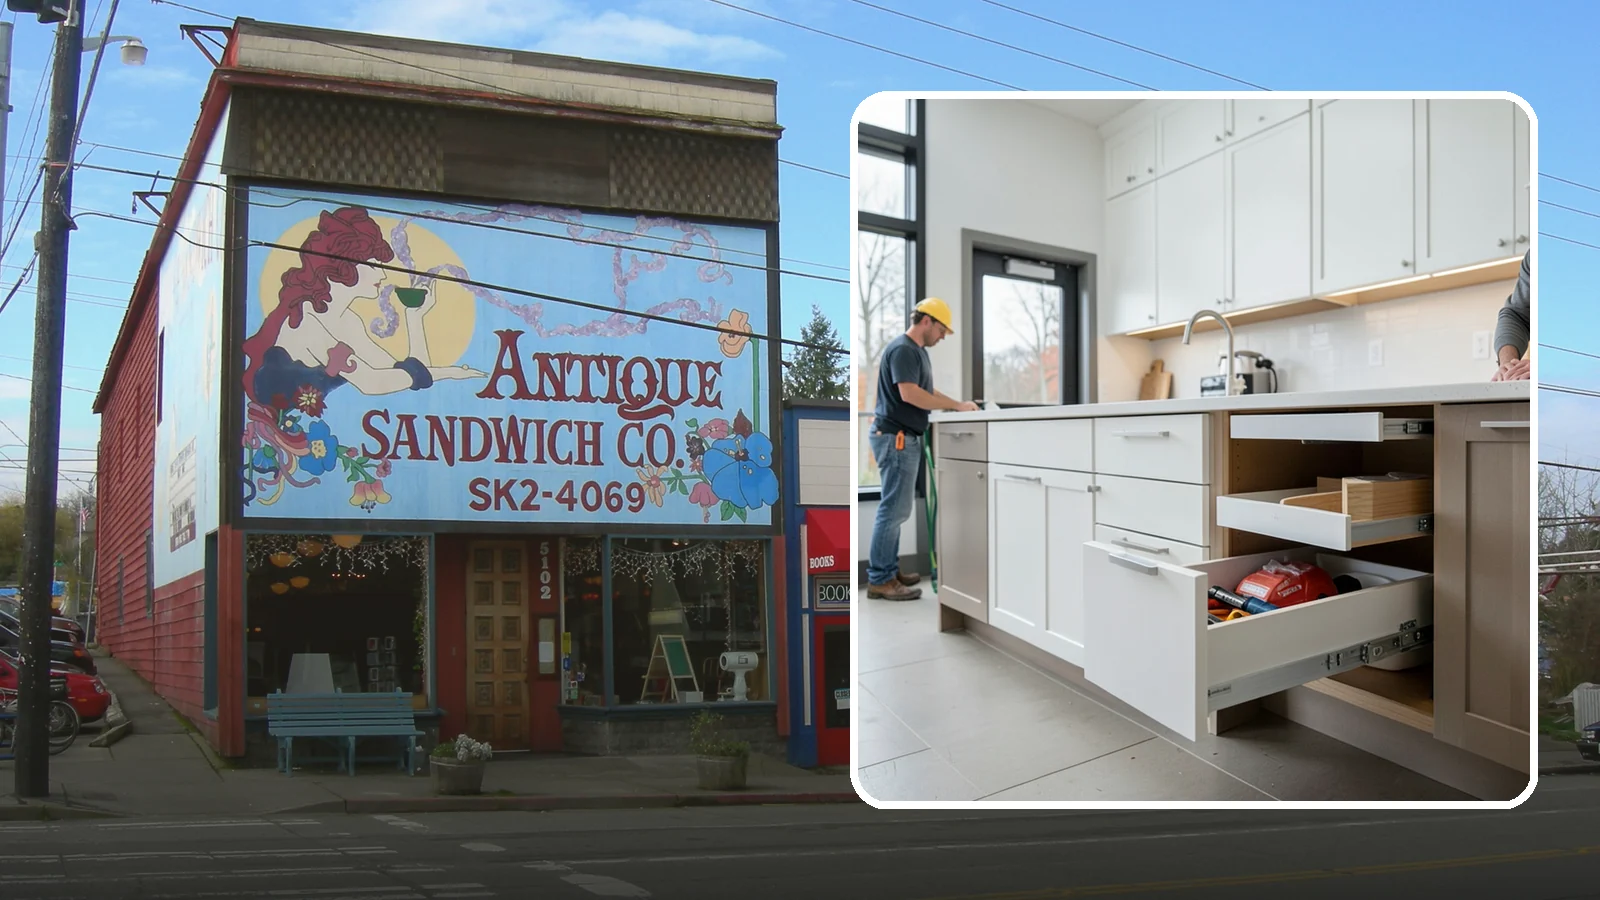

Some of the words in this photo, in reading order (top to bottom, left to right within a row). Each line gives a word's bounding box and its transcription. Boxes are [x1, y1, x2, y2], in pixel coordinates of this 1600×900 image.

[476, 330, 722, 420] ANTIQUE
[361, 409, 604, 466] SANDWICH
[618, 423, 684, 468] CO.
[468, 477, 645, 512] SK2-4069
[540, 542, 552, 600] 5102
[809, 555, 835, 569] BOOKS
